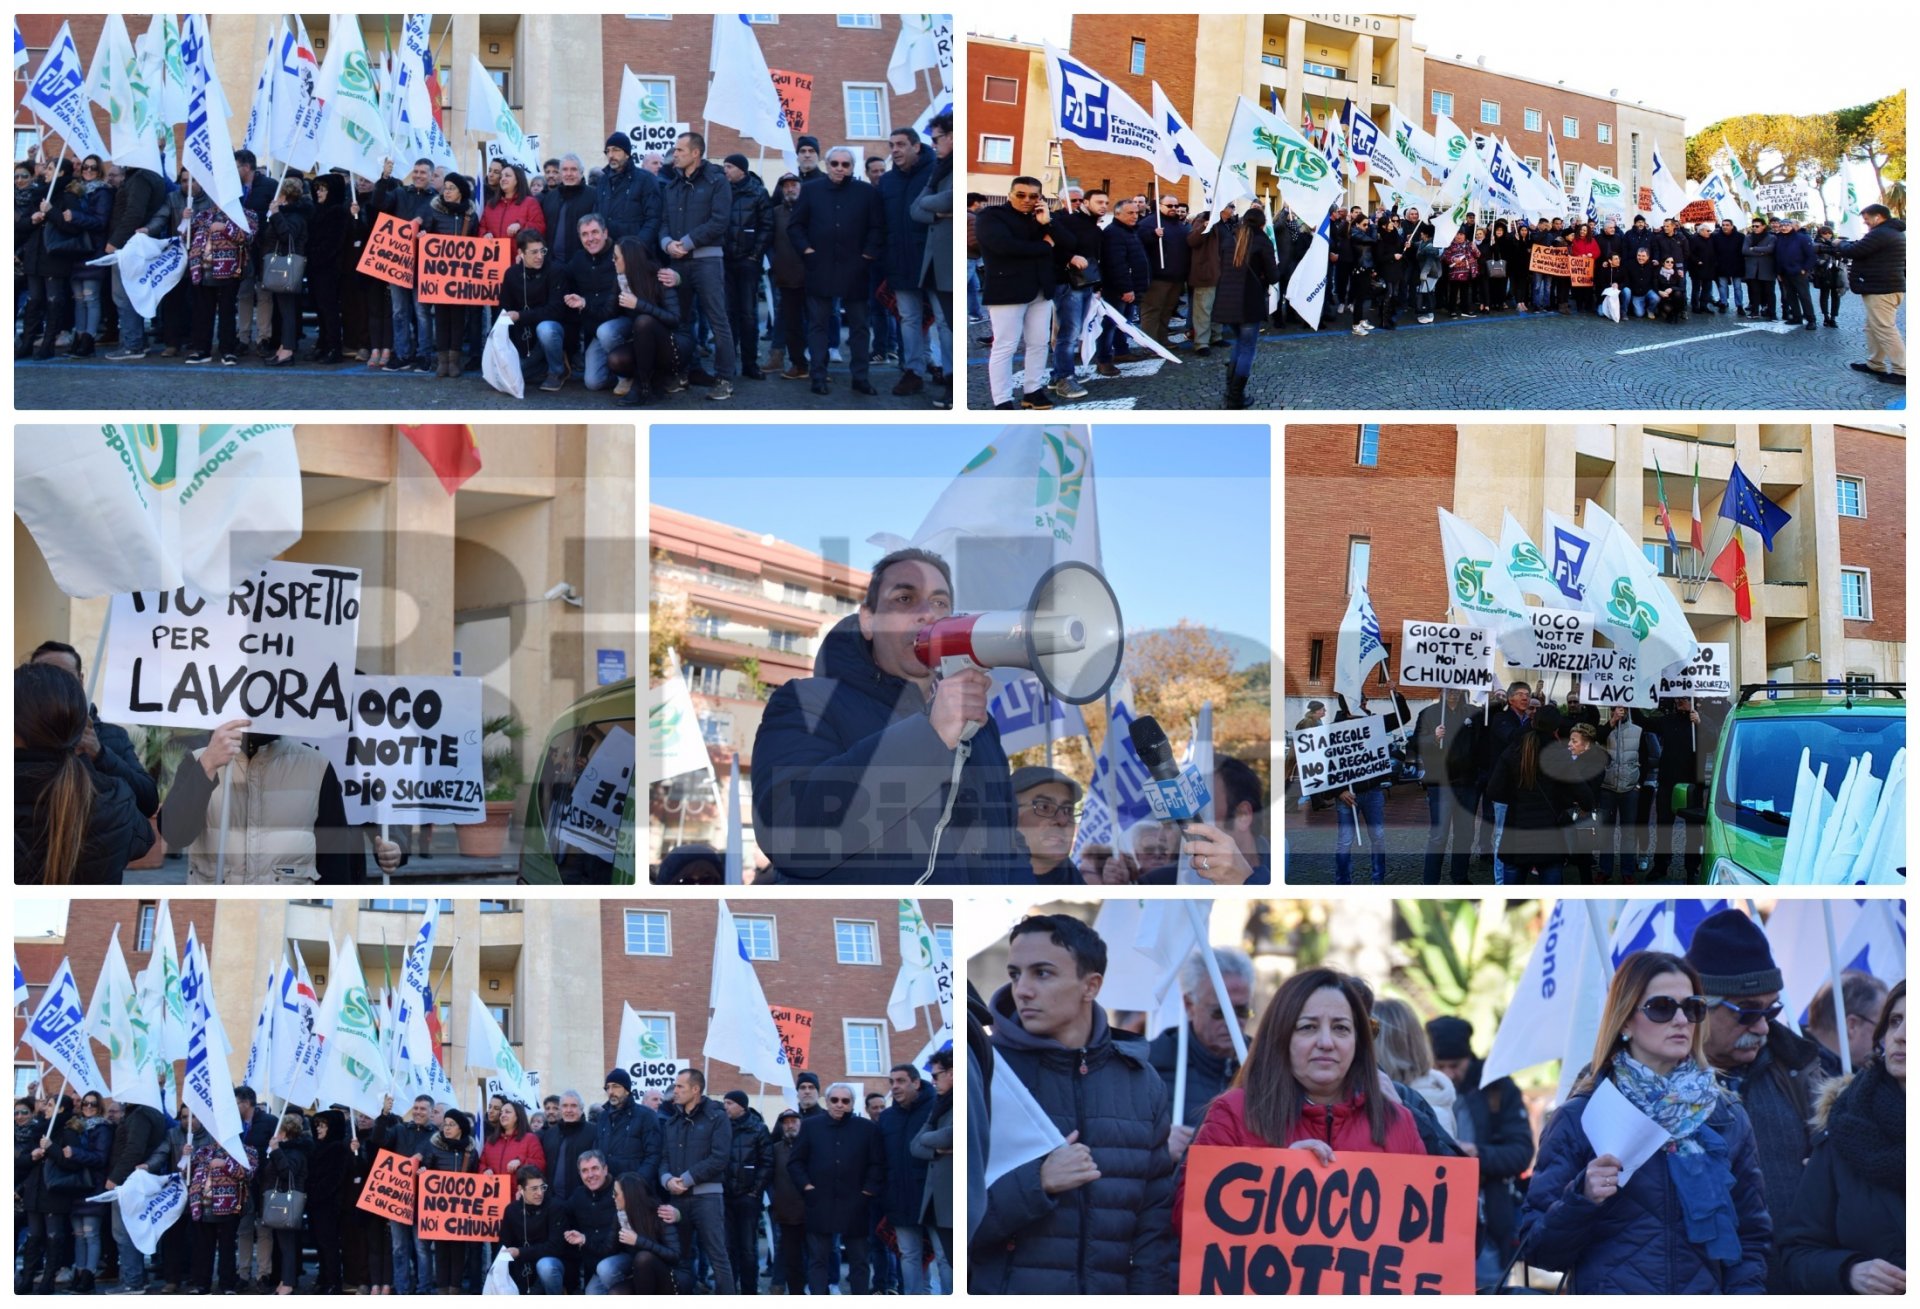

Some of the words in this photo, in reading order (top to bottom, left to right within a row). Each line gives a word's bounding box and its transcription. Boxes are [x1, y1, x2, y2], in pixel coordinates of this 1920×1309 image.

[424, 237, 476, 261] GIOCO
[423, 259, 485, 280] NOTTE
[152, 625, 210, 651] PER
[239, 632, 294, 657] CHI
[1409, 624, 1460, 639] GIOCO
[1534, 629, 1585, 645] NOTTE
[1482, 646, 1492, 656] E
[1536, 641, 1567, 651] ADDIO
[129, 657, 348, 721] LAVORA
[1595, 672, 1614, 682] PER
[348, 686, 442, 732] OCO
[1329, 726, 1371, 746] REGOLE
[346, 734, 458, 767] NOTTE
[1301, 762, 1324, 779] NO
[1328, 759, 1337, 772] A
[1340, 747, 1386, 769] REGOLE
[392, 777, 484, 803] SICUREZZA
[424, 1173, 476, 1197] GIOCO
[423, 1195, 485, 1216] NOTTE
[1204, 1161, 1381, 1242] GIOCO
[1200, 1242, 1405, 1295] NOTTE
